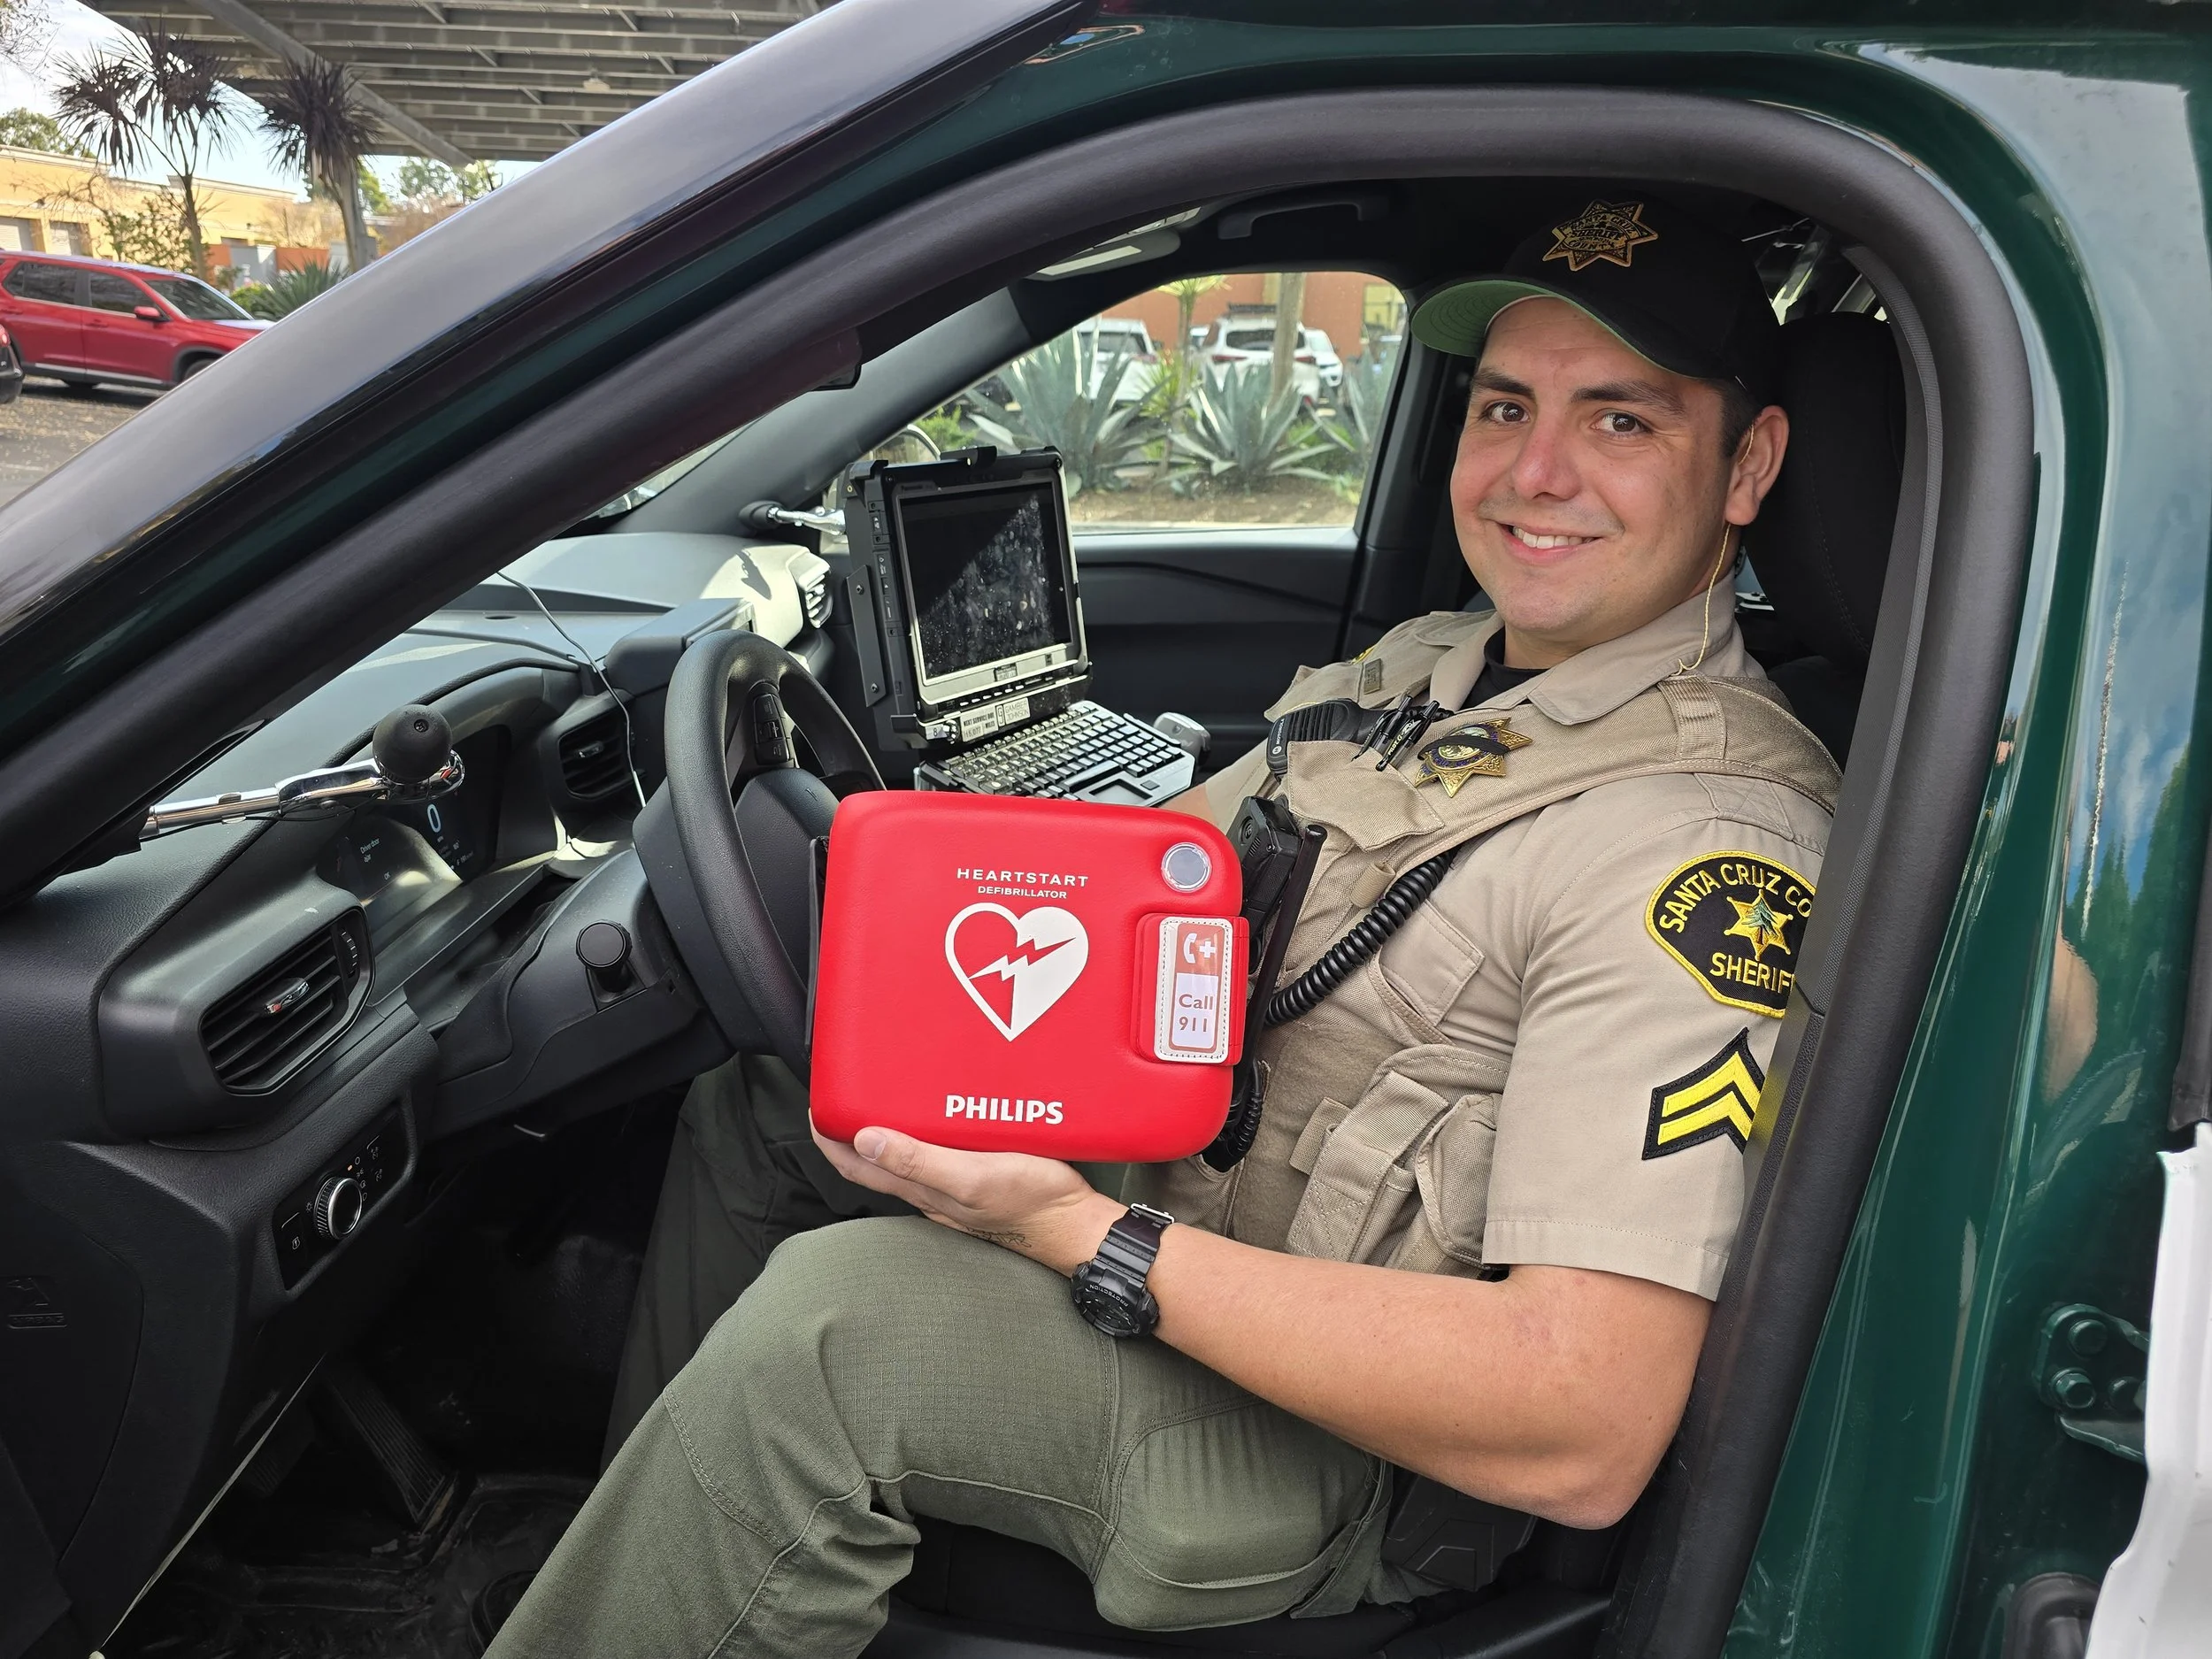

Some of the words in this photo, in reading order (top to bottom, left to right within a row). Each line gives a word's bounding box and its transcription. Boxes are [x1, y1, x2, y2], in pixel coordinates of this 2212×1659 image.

[1610, 217, 1636, 234] CRUZ
[1276, 718, 1285, 745] MOTOROLA
[1387, 740, 1399, 756] PILOT
[427, 803, 442, 833] 0
[956, 868, 1088, 887] HEARTSTART
[977, 886, 1067, 899] DEFIBRILLATOR
[1659, 870, 1721, 933] SANTA
[1720, 864, 1781, 895] CRUZ
[1179, 994, 1214, 1010] Call
[1179, 1016, 1208, 1033] 911
[945, 1094, 1064, 1125] PHILIPS
[1089, 1284, 1129, 1308] PROTECTION
